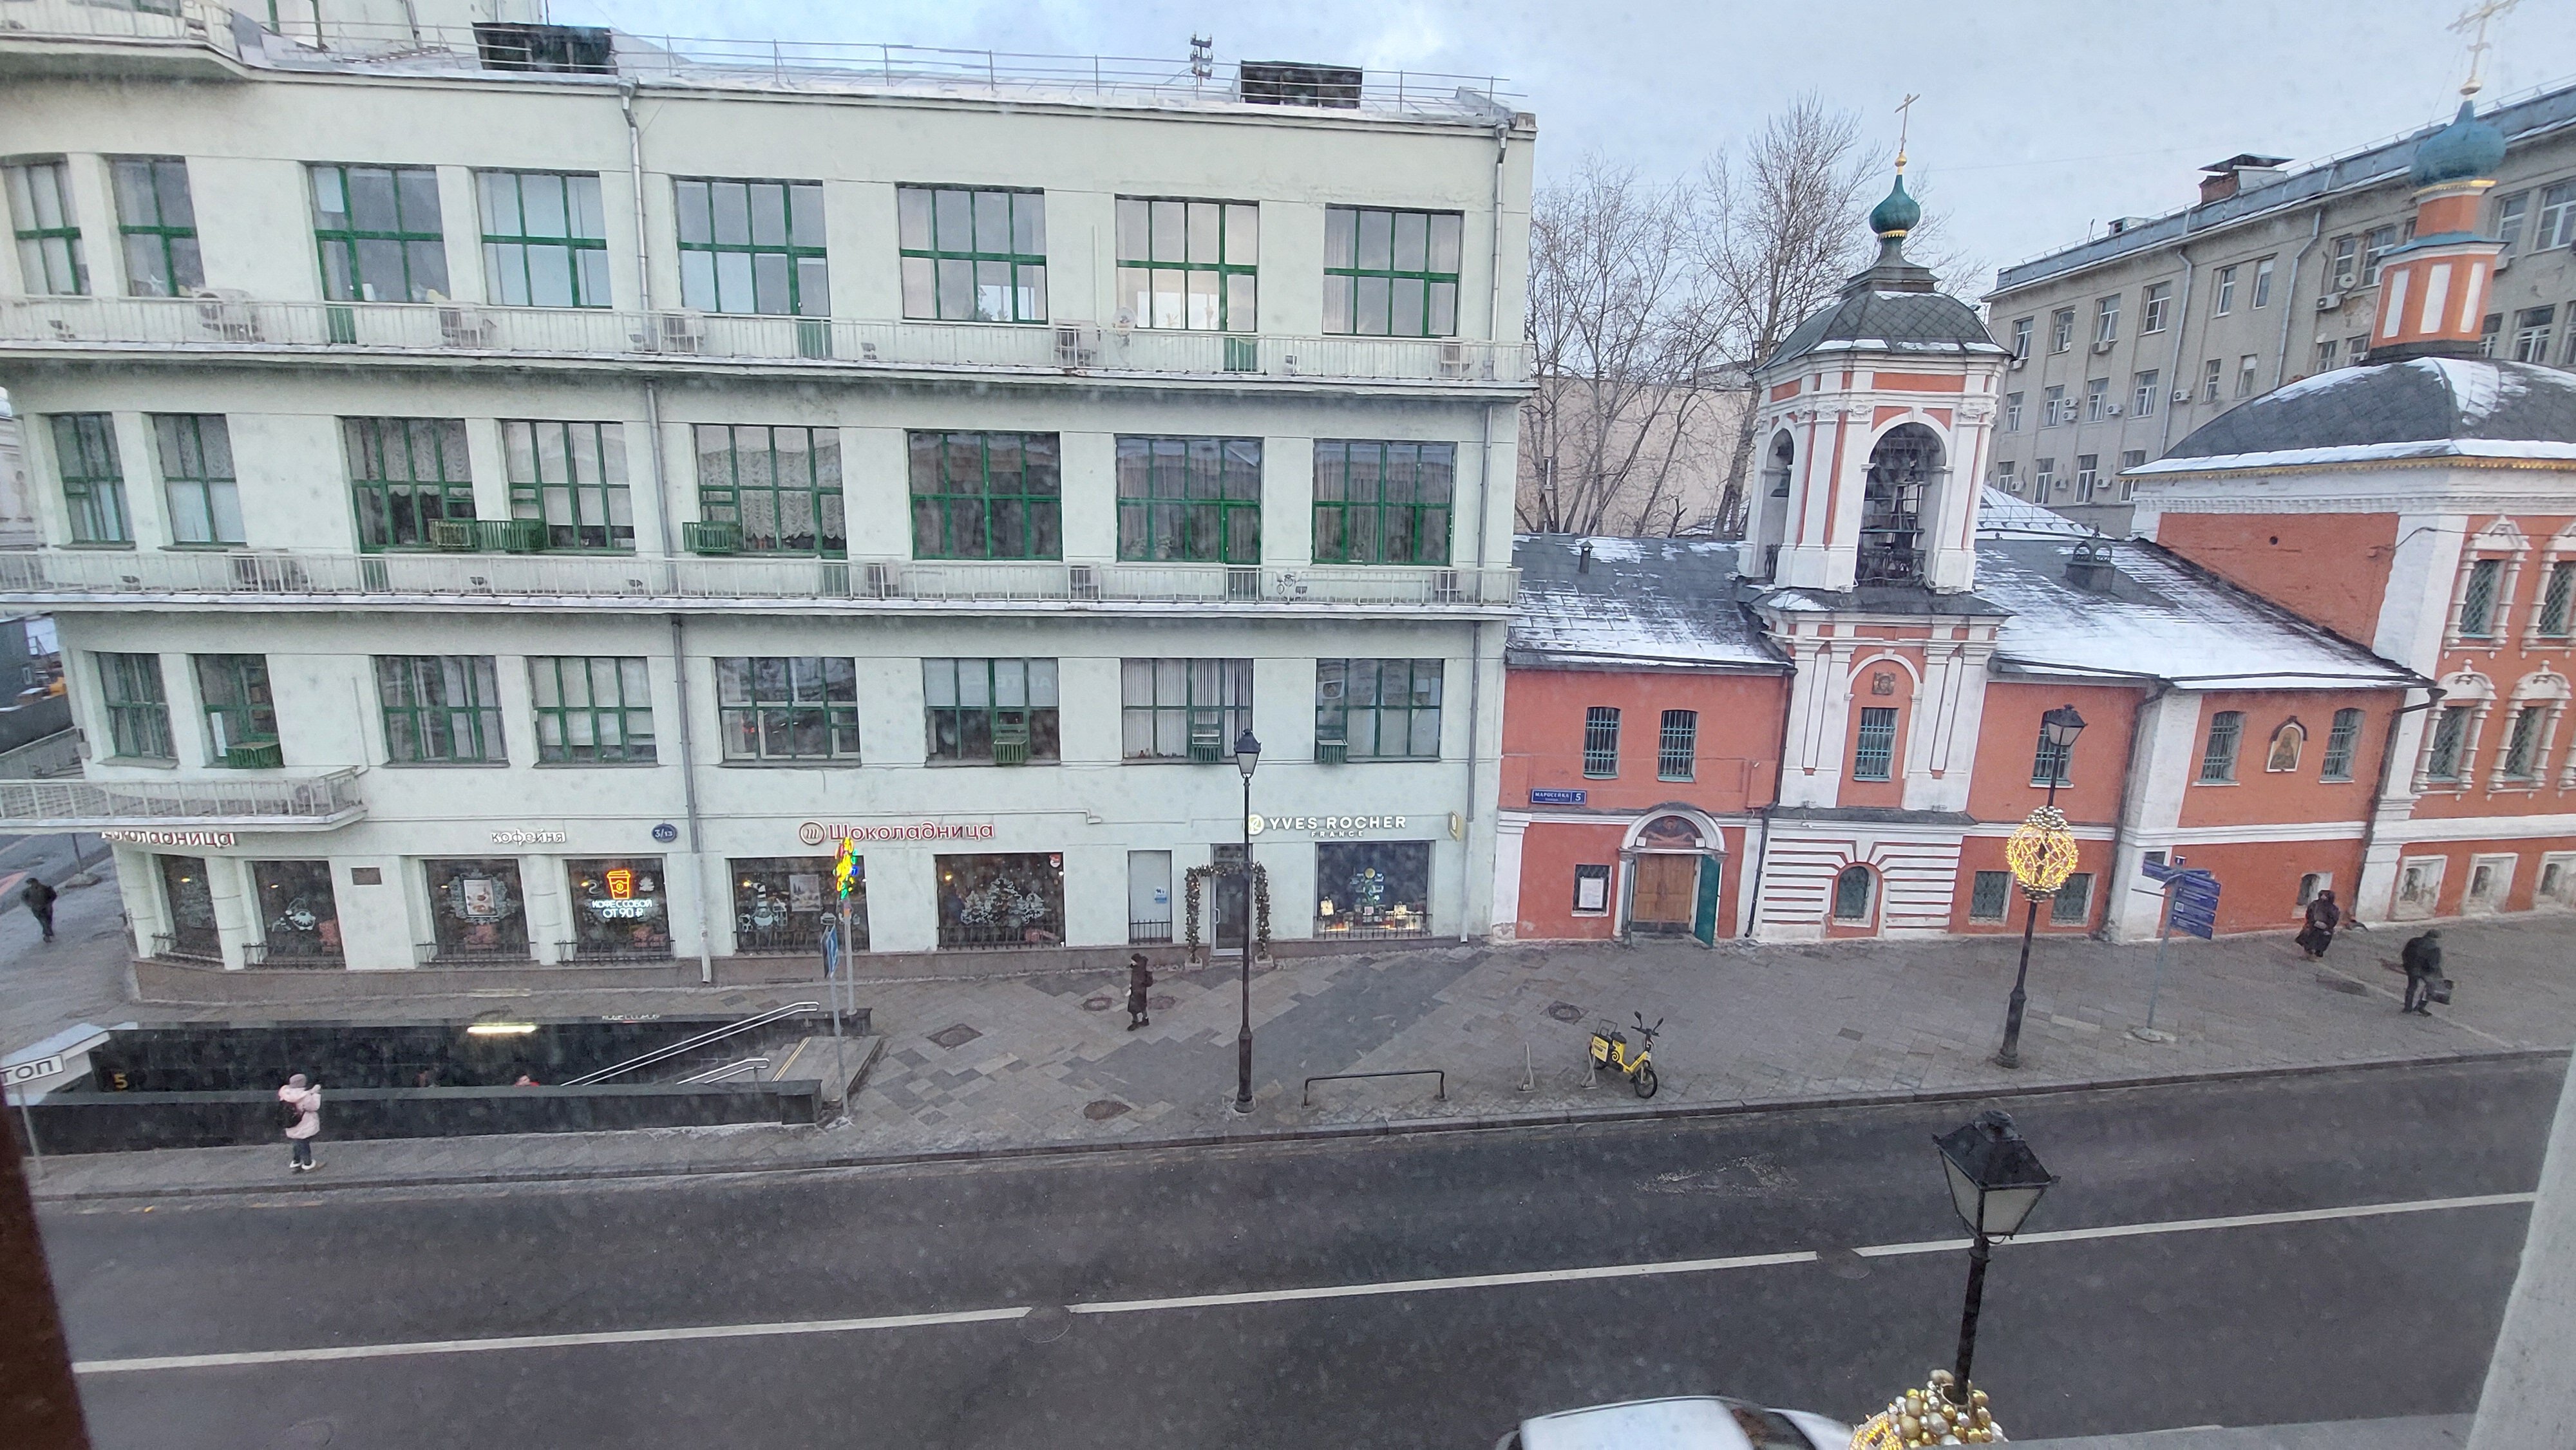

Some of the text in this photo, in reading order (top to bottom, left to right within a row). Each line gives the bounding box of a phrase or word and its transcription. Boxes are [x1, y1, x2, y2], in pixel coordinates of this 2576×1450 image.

[828, 821, 995, 842] Шоколадница
[1269, 817, 1318, 831] YVES
[1327, 816, 1406, 829] ROCHER
[101, 831, 236, 848] околадница
[491, 829, 566, 847] кофейня
[592, 899, 652, 909] КОФЕ С СОБОЙ
[603, 908, 618, 918] ОТ
[619, 908, 634, 918] 90
[113, 1073, 129, 1089] 5
